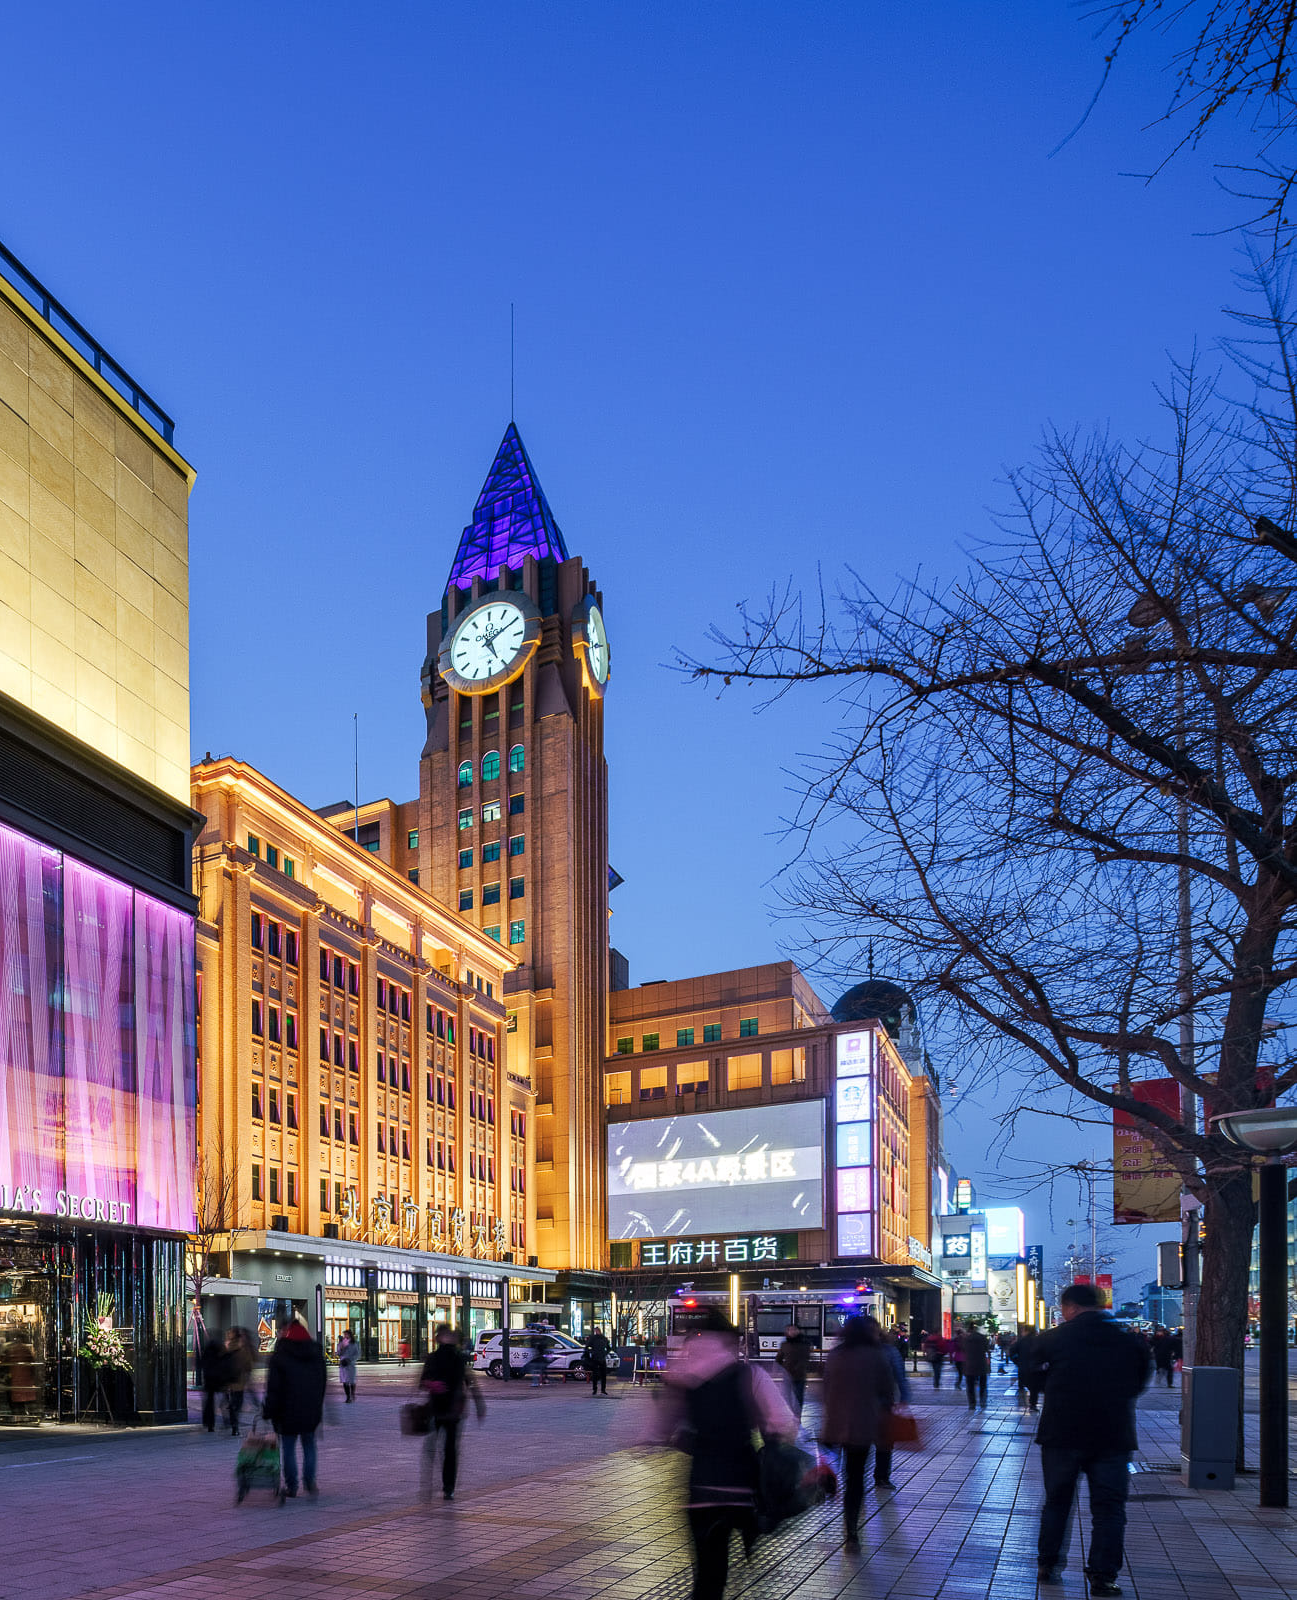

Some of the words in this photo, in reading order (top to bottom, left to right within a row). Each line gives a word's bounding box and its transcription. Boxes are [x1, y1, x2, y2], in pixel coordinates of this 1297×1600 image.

[475, 627, 503, 642] OMEGA
[56, 1190, 131, 1226] SECRET
[341, 1185, 506, 1255] 北京市百货大楼
[642, 1236, 778, 1266] 王府井百货
